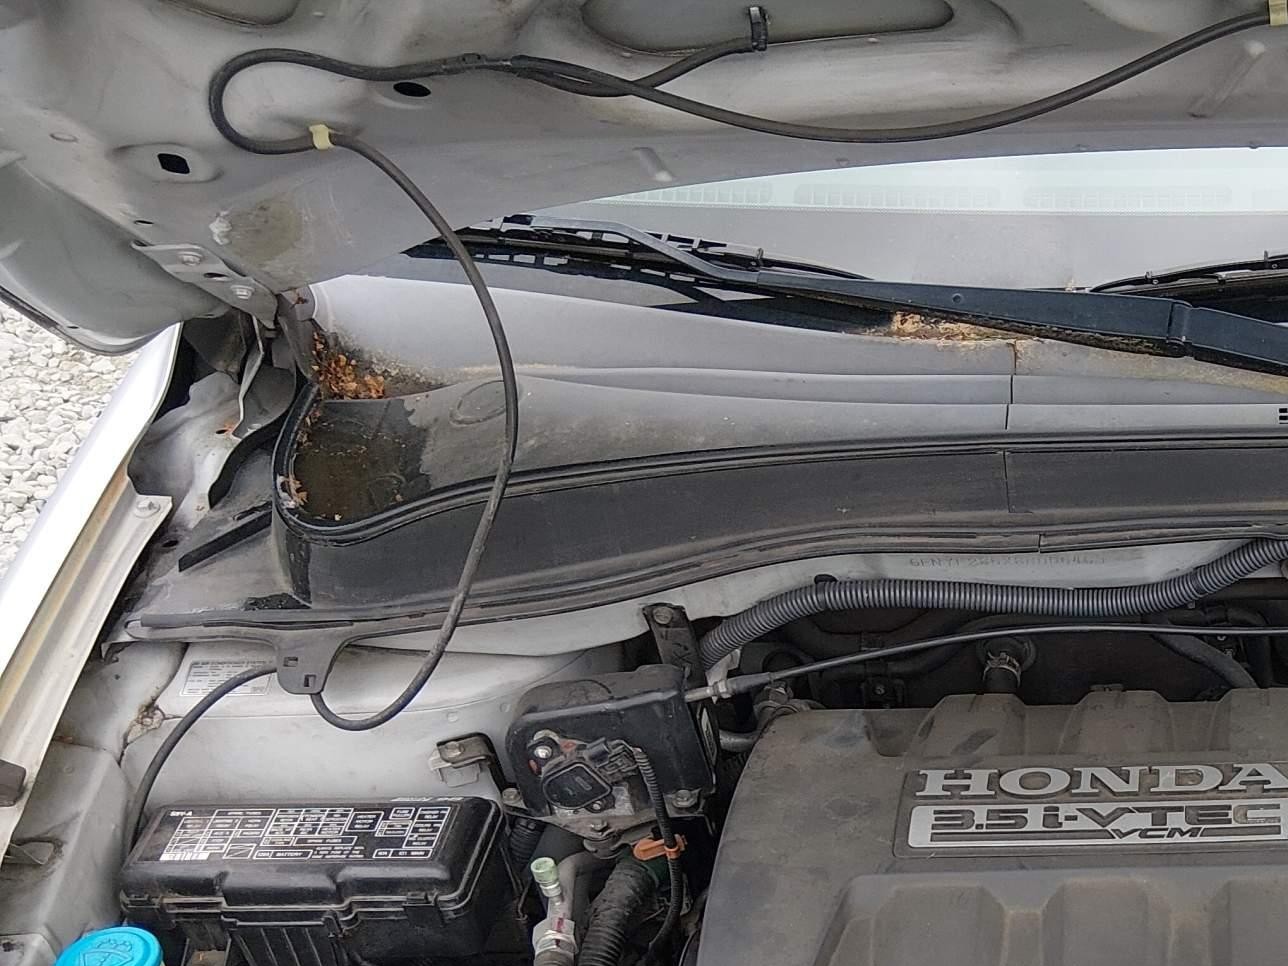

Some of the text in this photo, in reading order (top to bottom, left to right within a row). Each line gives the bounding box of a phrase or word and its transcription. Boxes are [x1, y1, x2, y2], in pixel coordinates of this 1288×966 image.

[931, 803, 1282, 830] 3.5 i-VTEC
[1112, 826, 1206, 839] VCM
